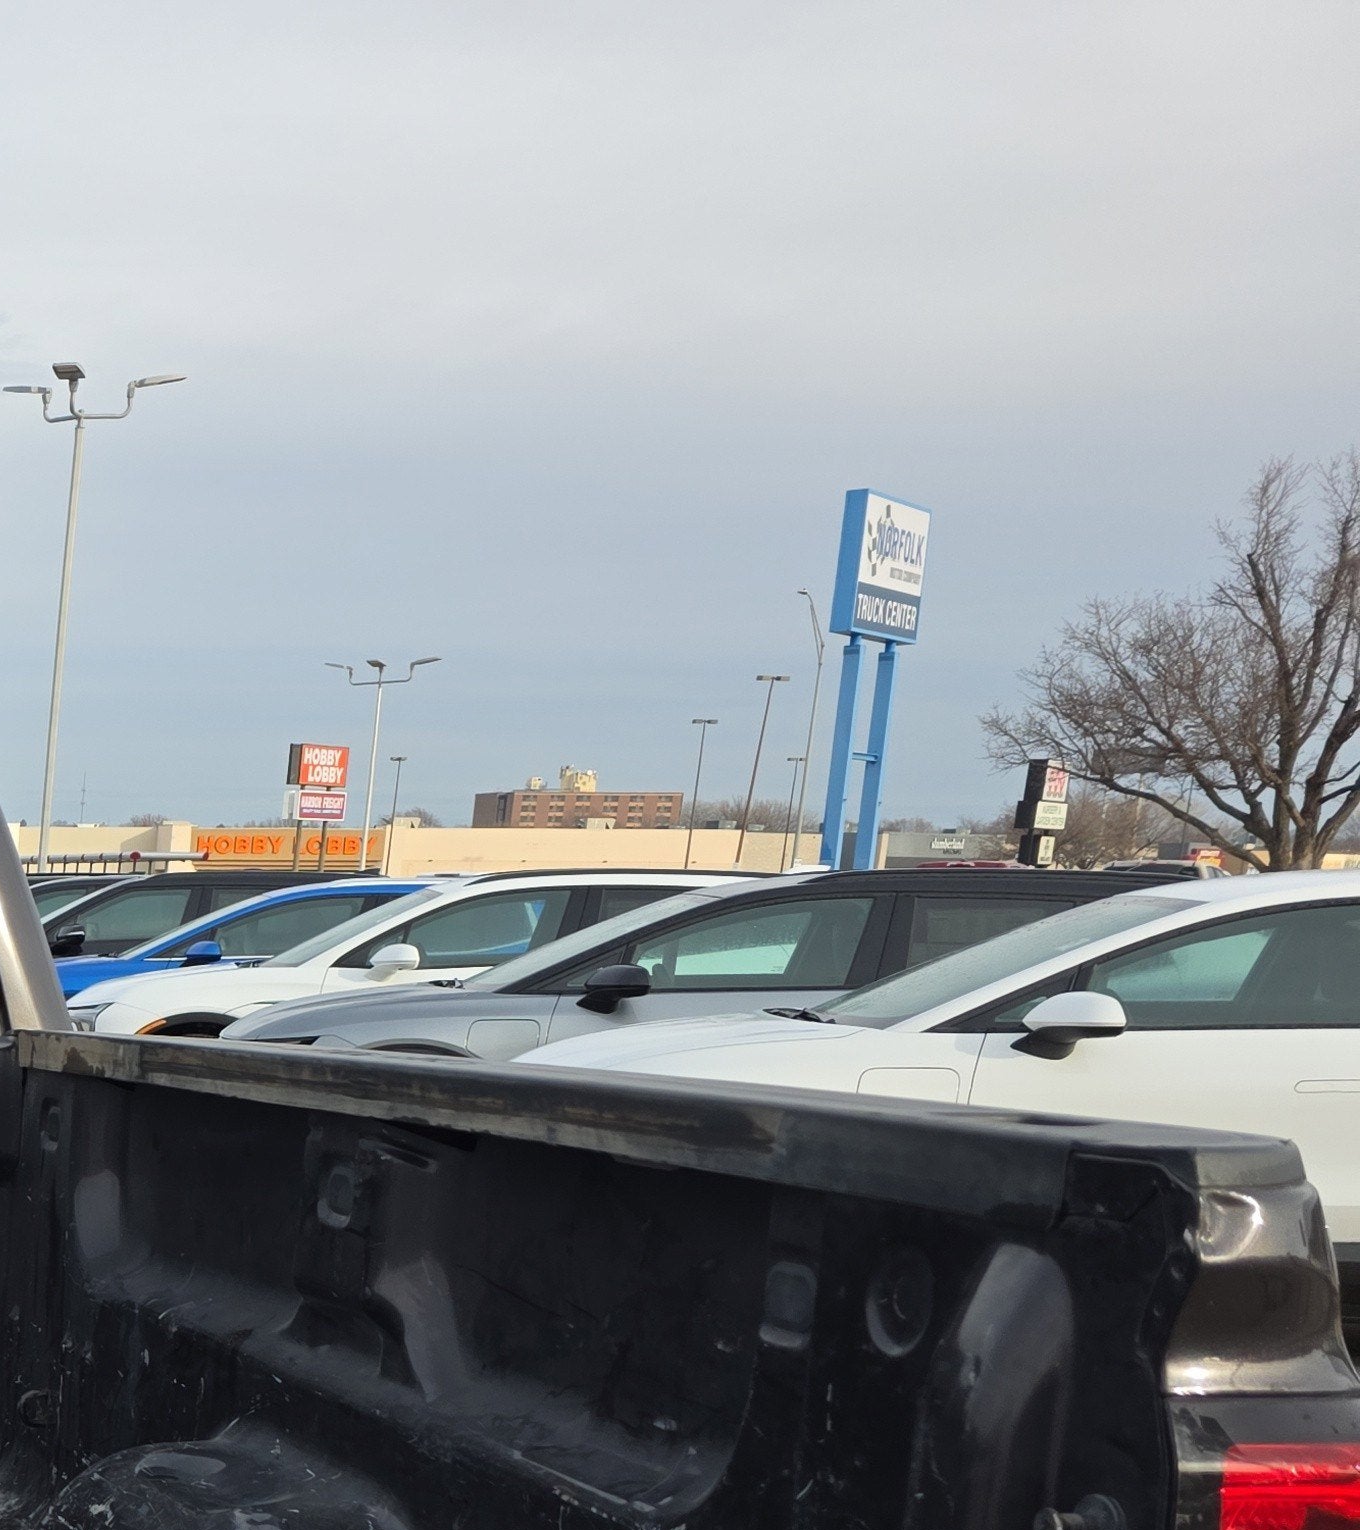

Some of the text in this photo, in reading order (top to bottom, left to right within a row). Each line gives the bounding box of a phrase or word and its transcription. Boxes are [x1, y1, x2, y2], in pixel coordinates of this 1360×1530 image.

[876, 522, 925, 566] NORFOLK
[857, 594, 917, 631] TRUCK CENTER
[304, 747, 342, 767] HOBBY
[308, 765, 344, 784] LOBBY
[197, 836, 284, 855] HOBBY
